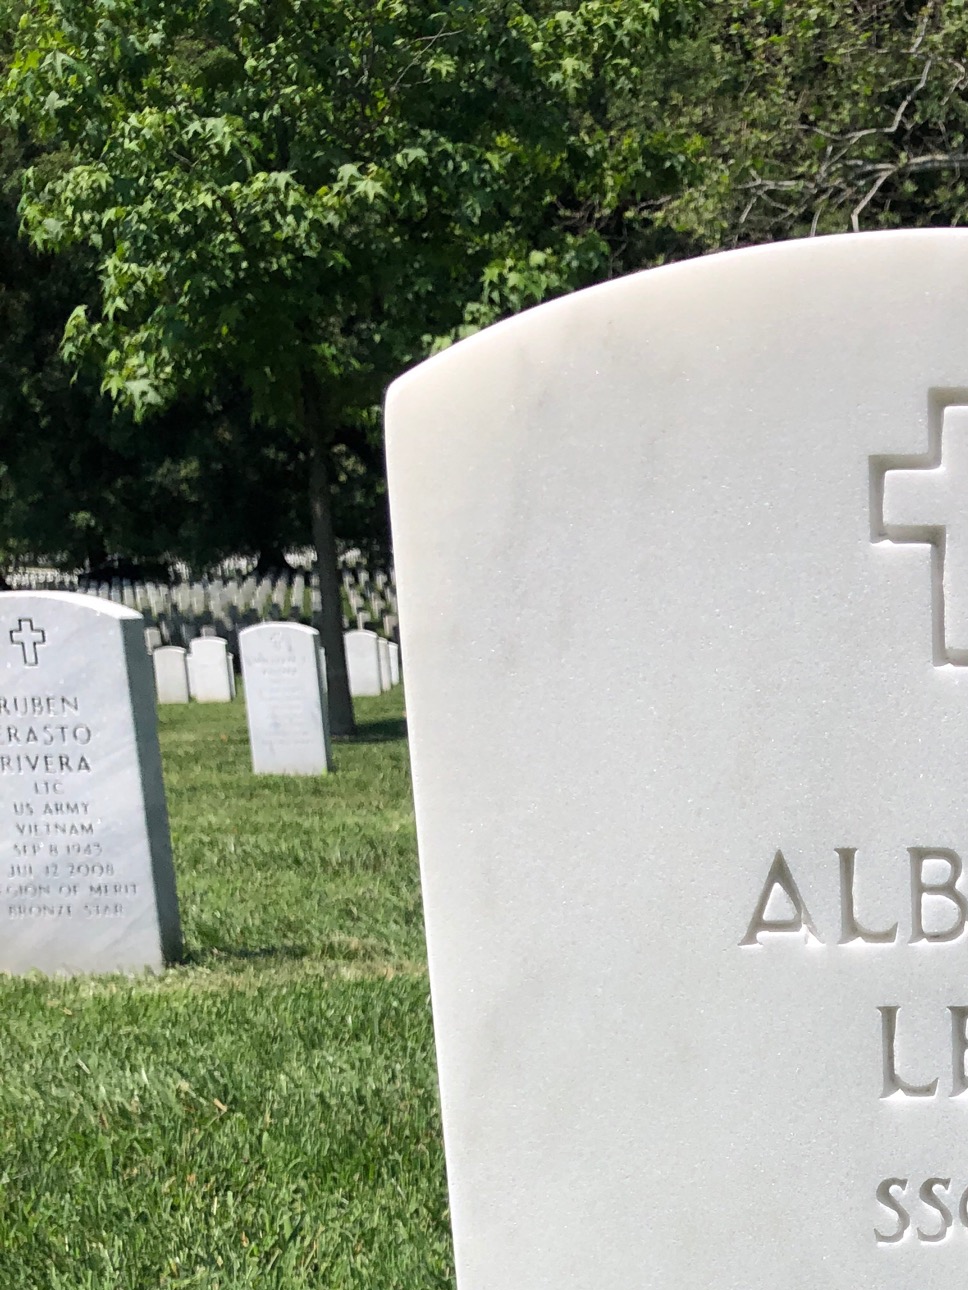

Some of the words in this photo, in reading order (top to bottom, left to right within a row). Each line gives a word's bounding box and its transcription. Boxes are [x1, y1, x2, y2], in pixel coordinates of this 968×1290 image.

[0, 696, 79, 715] RUBEN
[0, 724, 91, 745] RASTO
[0, 753, 91, 774] RIVERA
[13, 802, 34, 816] US
[43, 801, 90, 816] ARMY
[15, 822, 94, 836] VIETNAM
